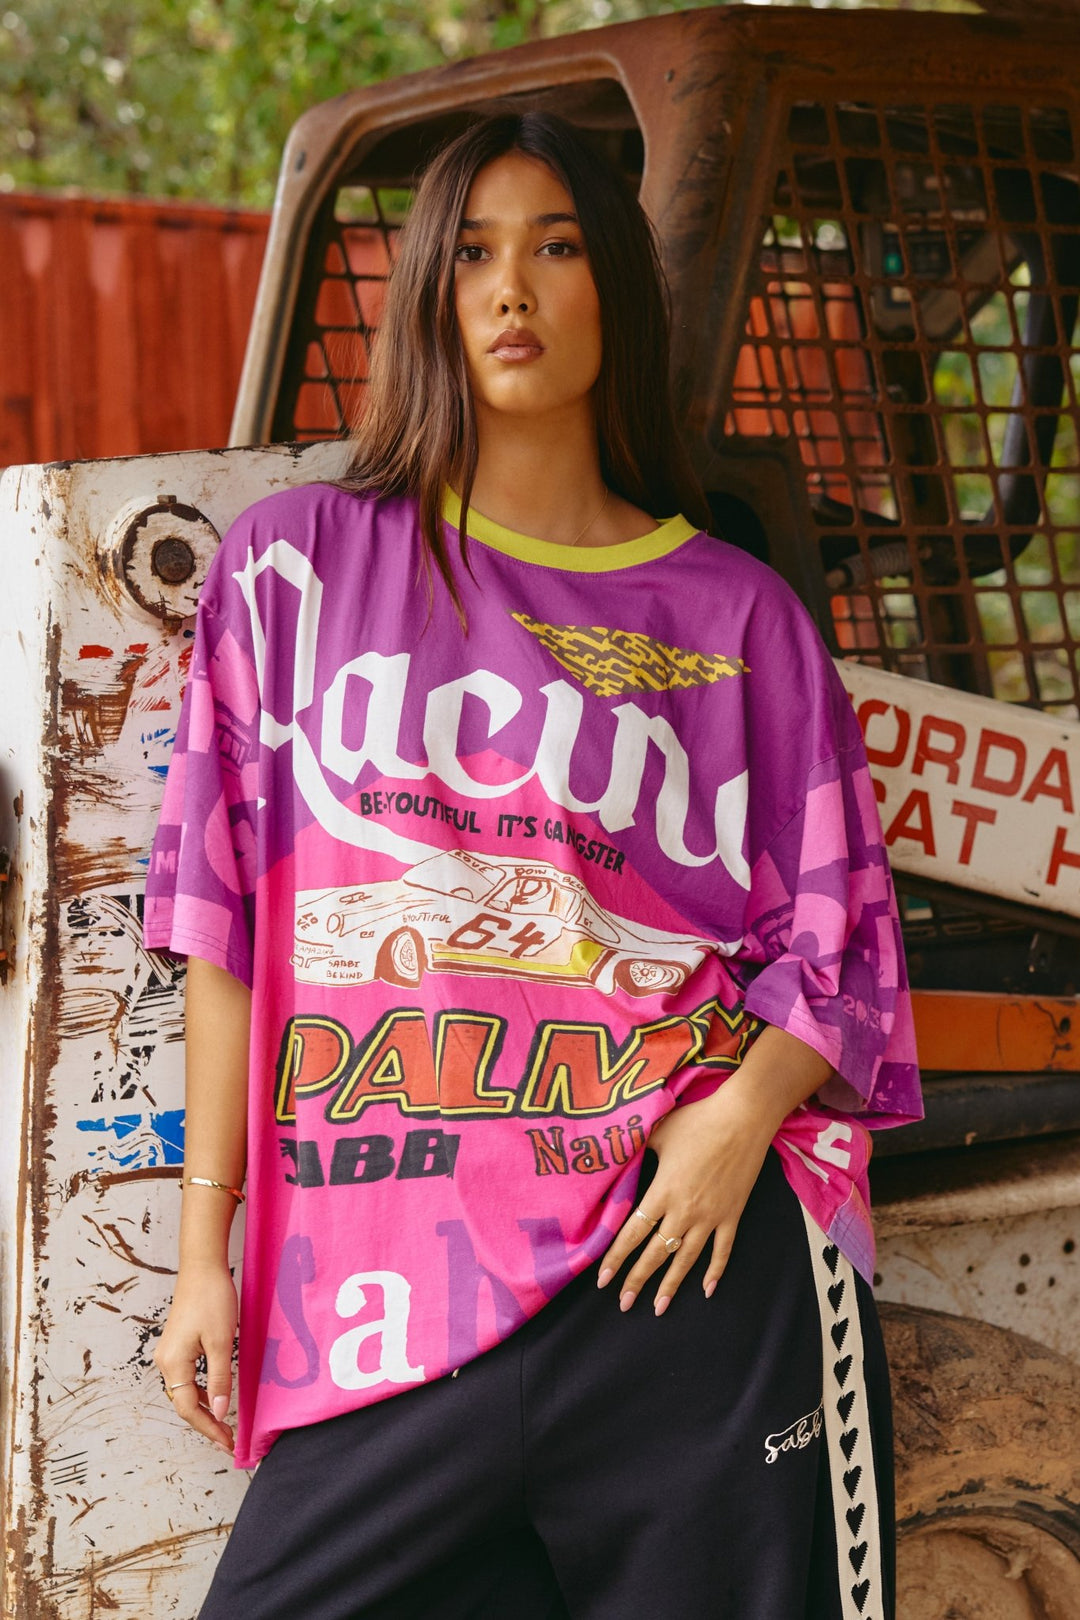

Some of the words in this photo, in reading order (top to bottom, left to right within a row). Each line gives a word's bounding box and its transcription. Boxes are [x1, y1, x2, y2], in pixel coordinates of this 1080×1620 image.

[846, 691, 1075, 815] ORDA
[497, 813, 538, 838] IT'S
[544, 817, 627, 876] GANGSTER
[447, 912, 545, 960] 64
[524, 1114, 662, 1177] Nati
